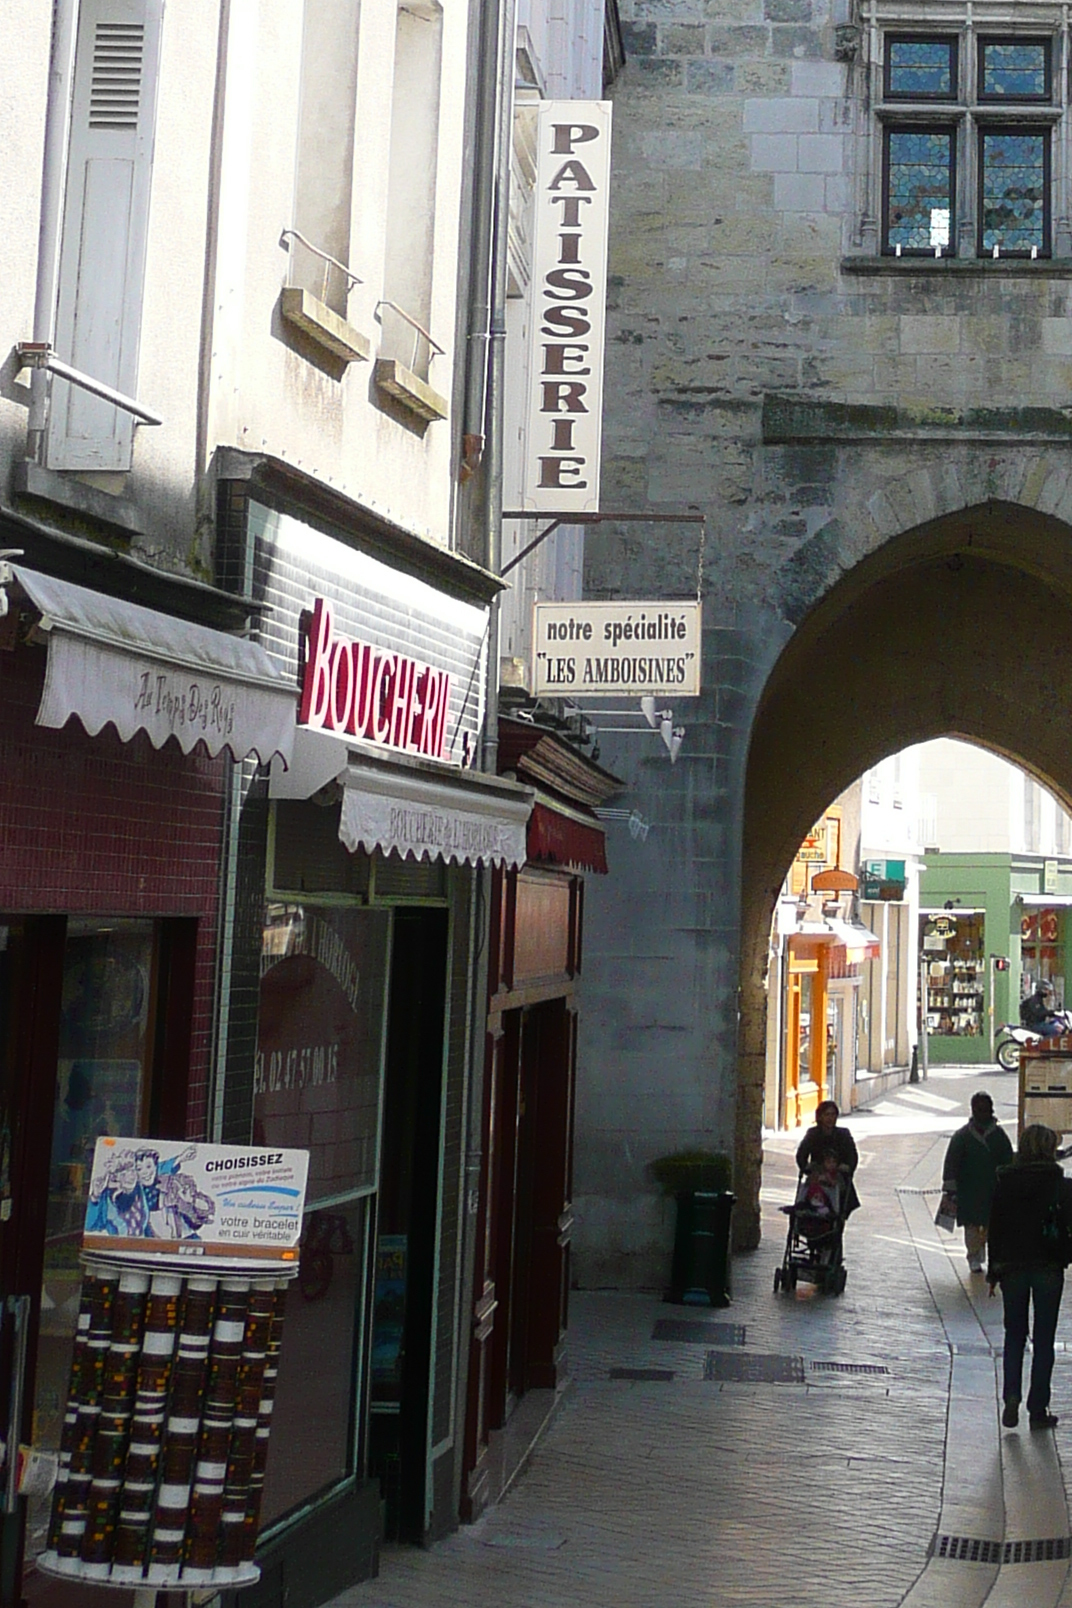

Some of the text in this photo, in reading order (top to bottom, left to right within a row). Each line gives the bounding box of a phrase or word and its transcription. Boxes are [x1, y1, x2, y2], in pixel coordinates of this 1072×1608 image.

[535, 123, 600, 490] PATISSERIE
[547, 613, 686, 647] notre spécialité
[302, 598, 459, 762] BOUCHERIE
[1050, 1037, 1068, 1051] LE
[205, 1153, 283, 1172] CHOISISSEZ
[220, 1216, 299, 1231] votre bracelet
[218, 1229, 291, 1241] en cuir véritable
